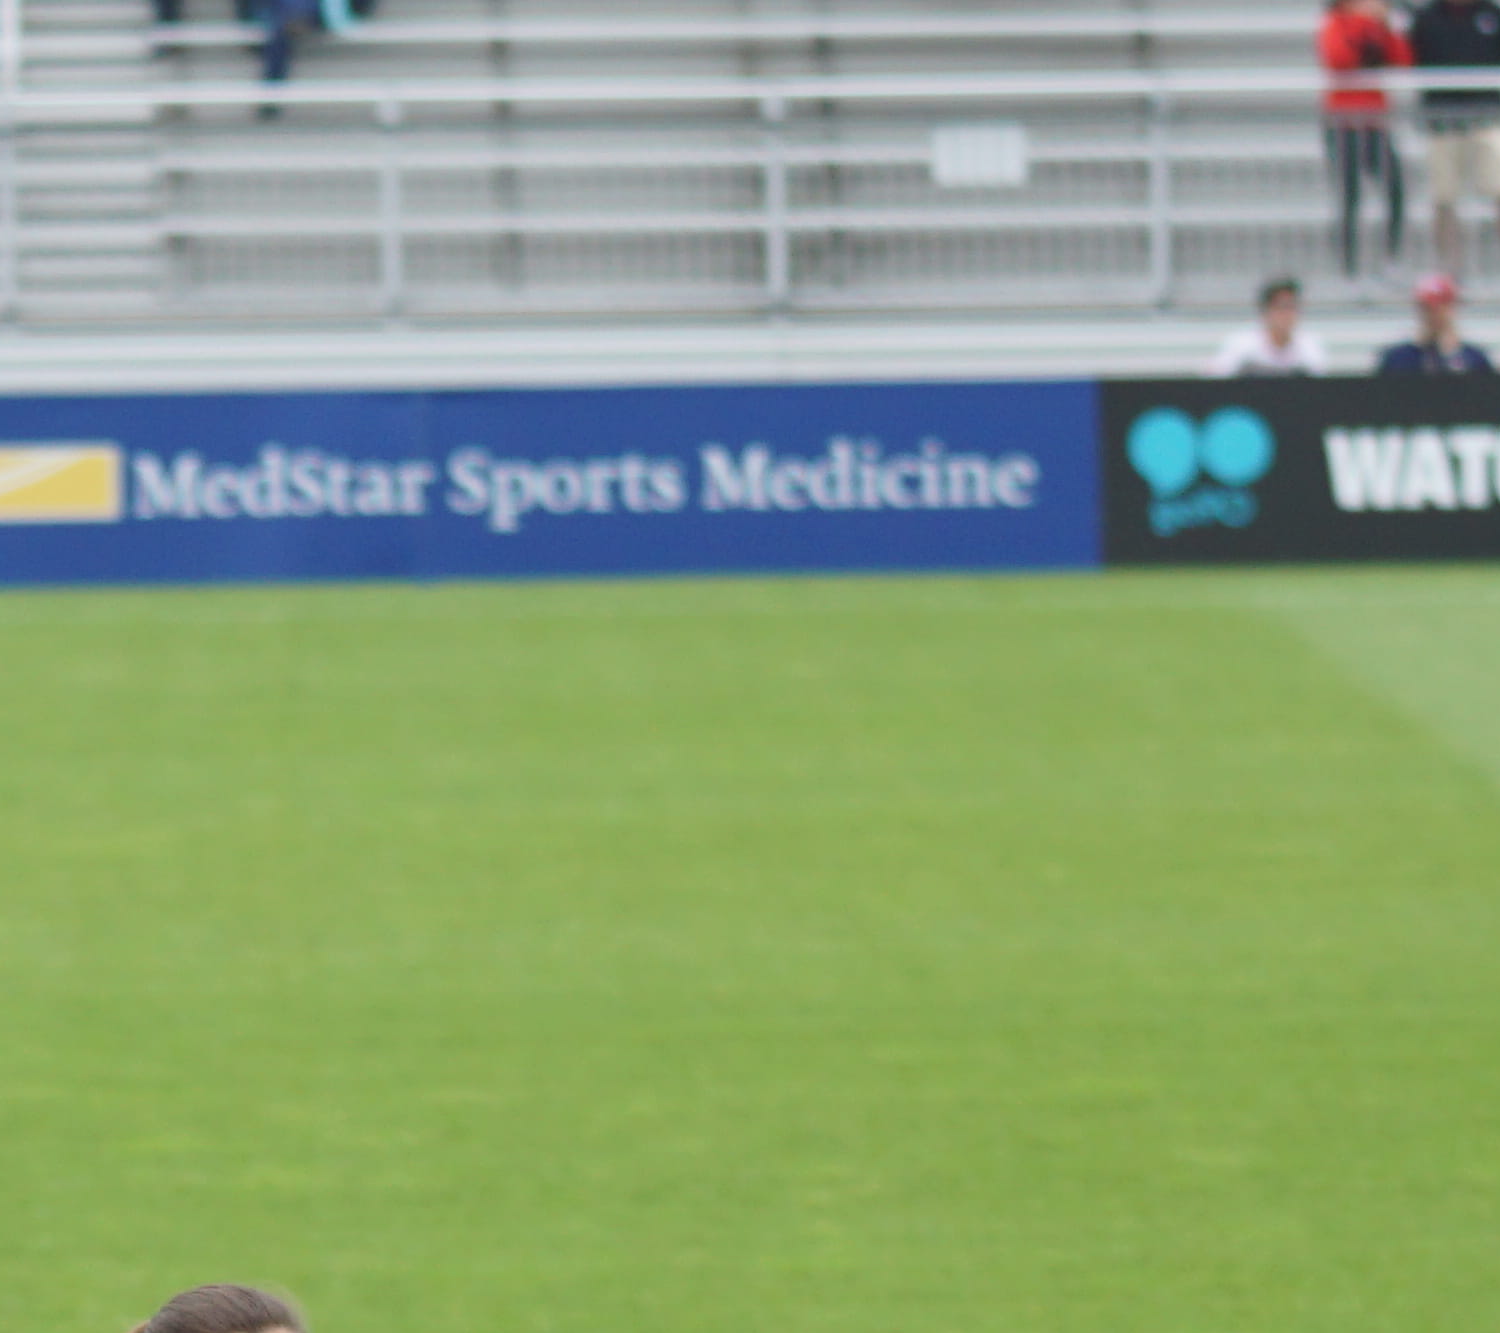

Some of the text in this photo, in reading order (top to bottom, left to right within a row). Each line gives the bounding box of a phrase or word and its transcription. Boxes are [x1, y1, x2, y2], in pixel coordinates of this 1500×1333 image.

[134, 438, 1040, 532] MedStar Sports Medicine
